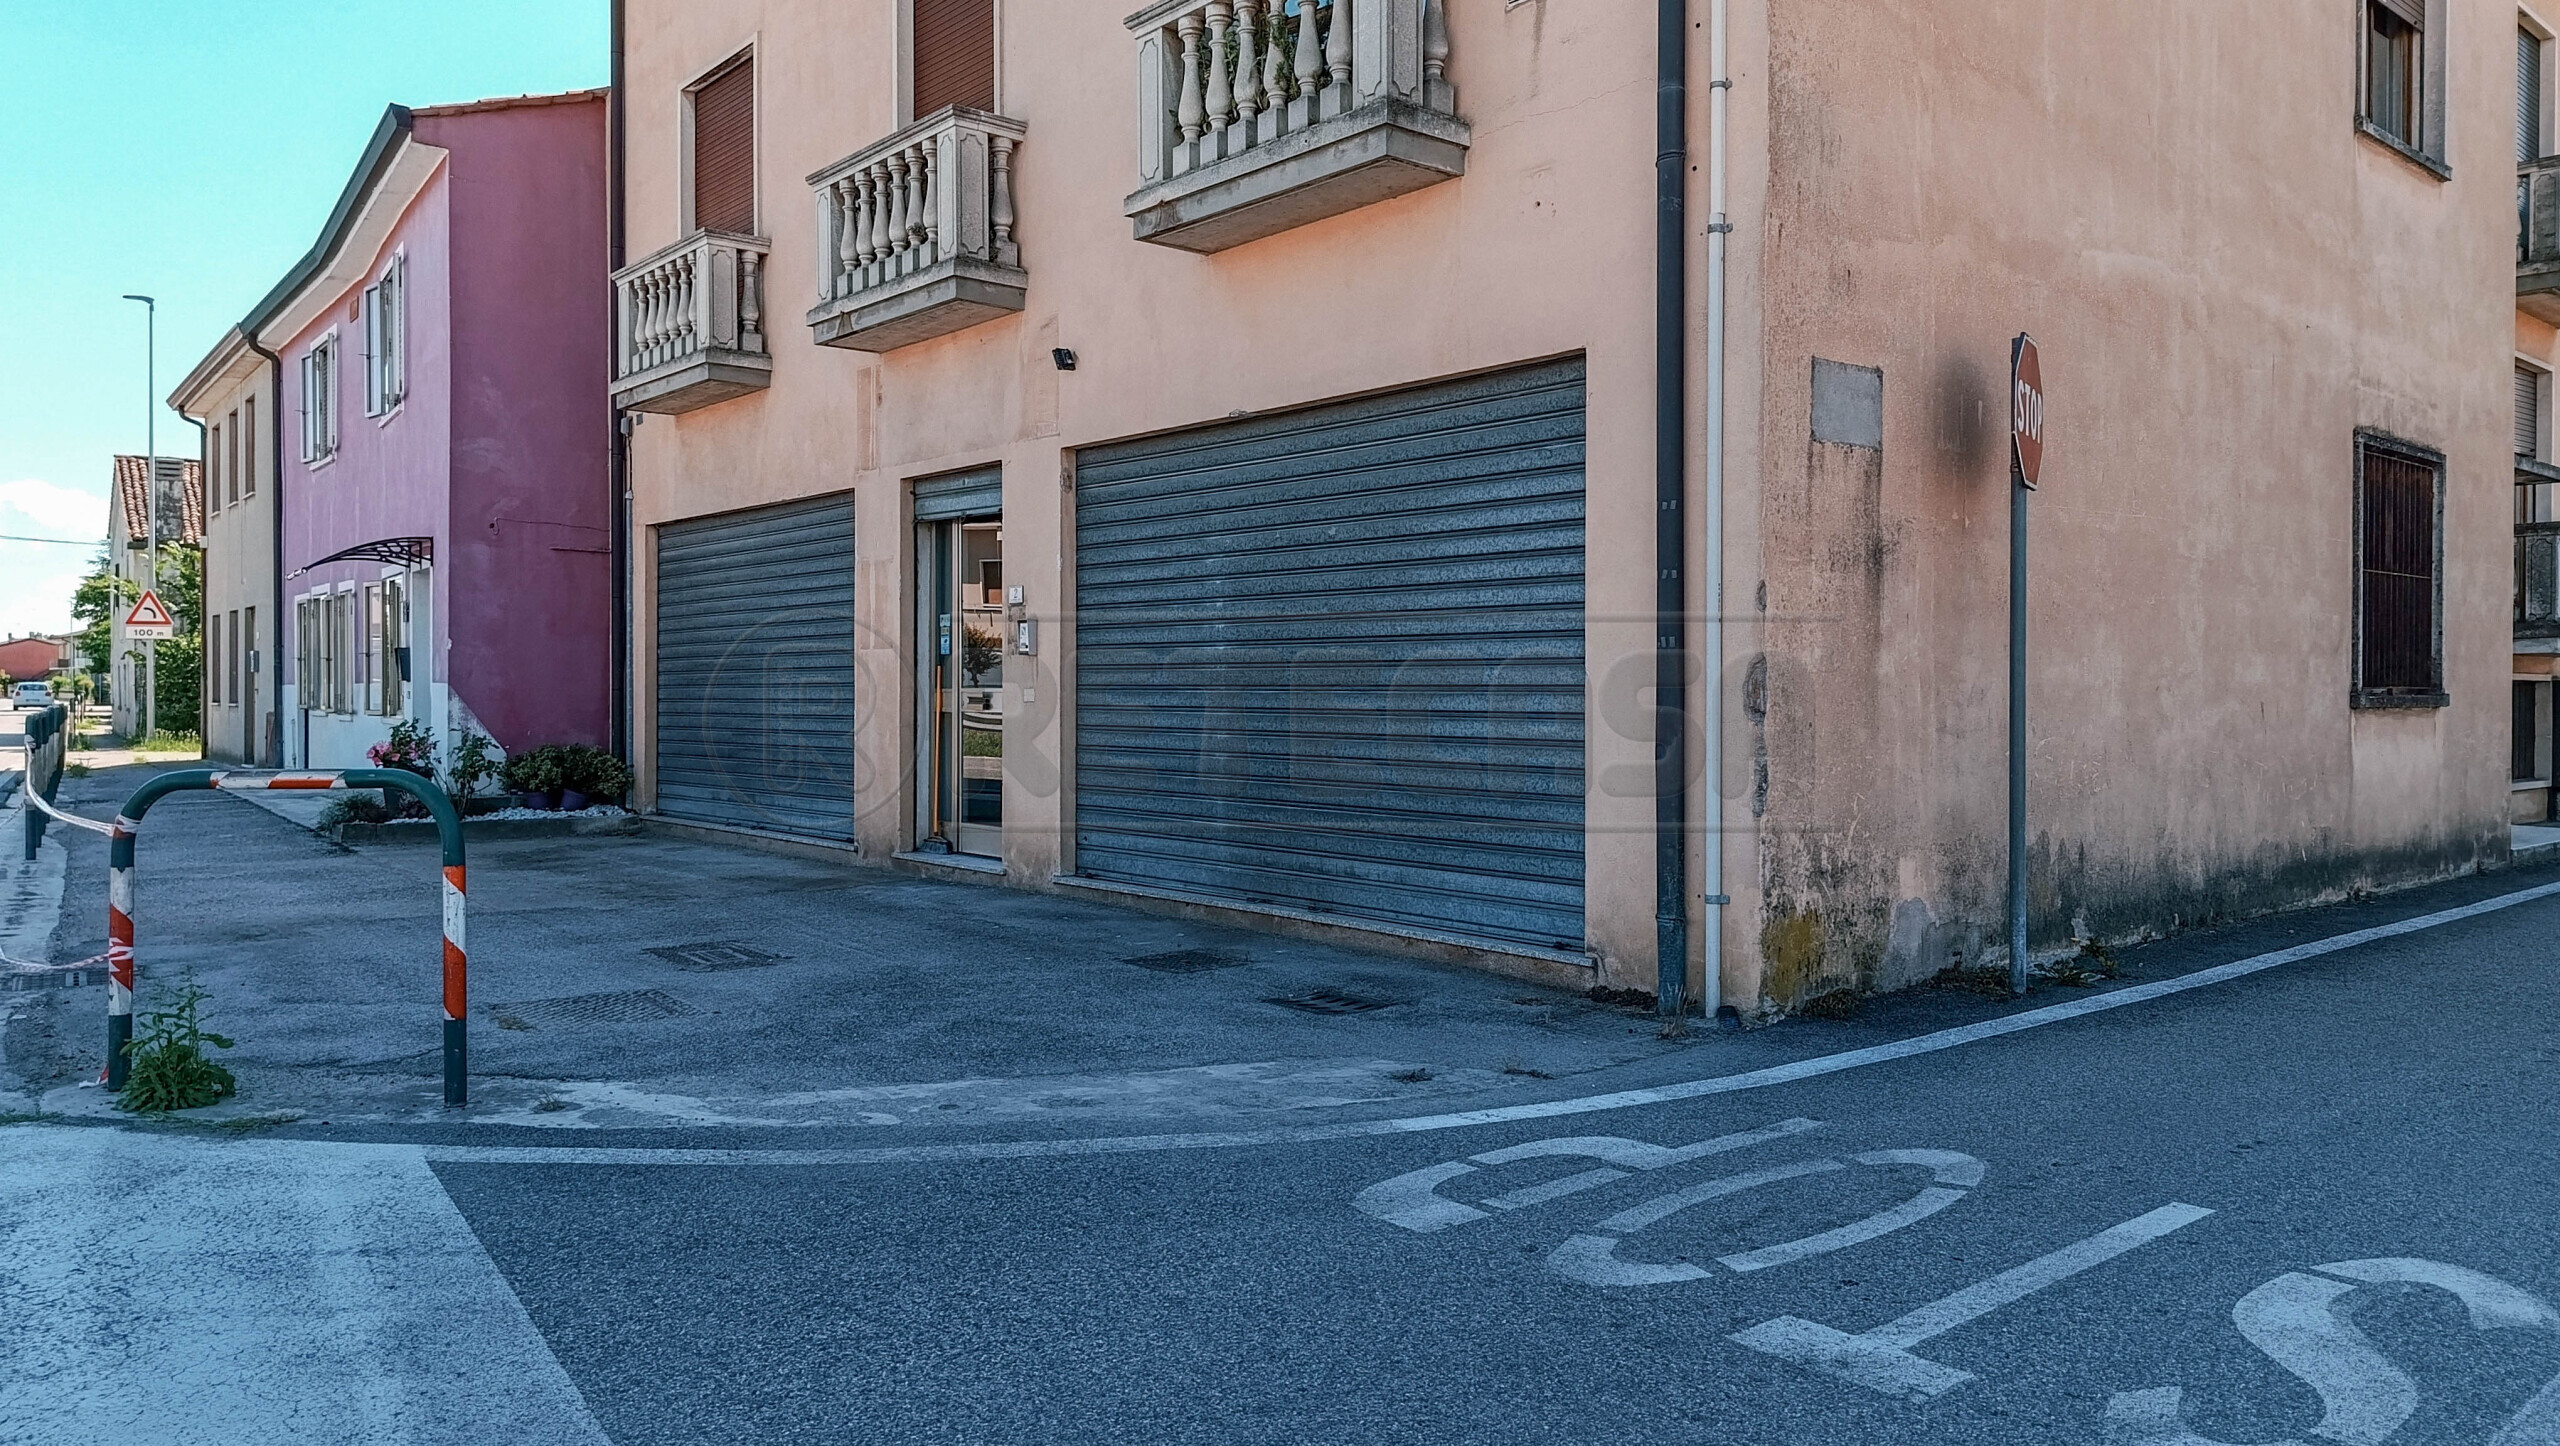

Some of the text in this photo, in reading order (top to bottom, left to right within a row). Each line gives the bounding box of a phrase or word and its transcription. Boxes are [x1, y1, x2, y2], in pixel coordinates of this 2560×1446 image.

[2017, 379, 2043, 444] STOP
[134, 629, 154, 637] 100
[1354, 1118, 2560, 1446] STOP
